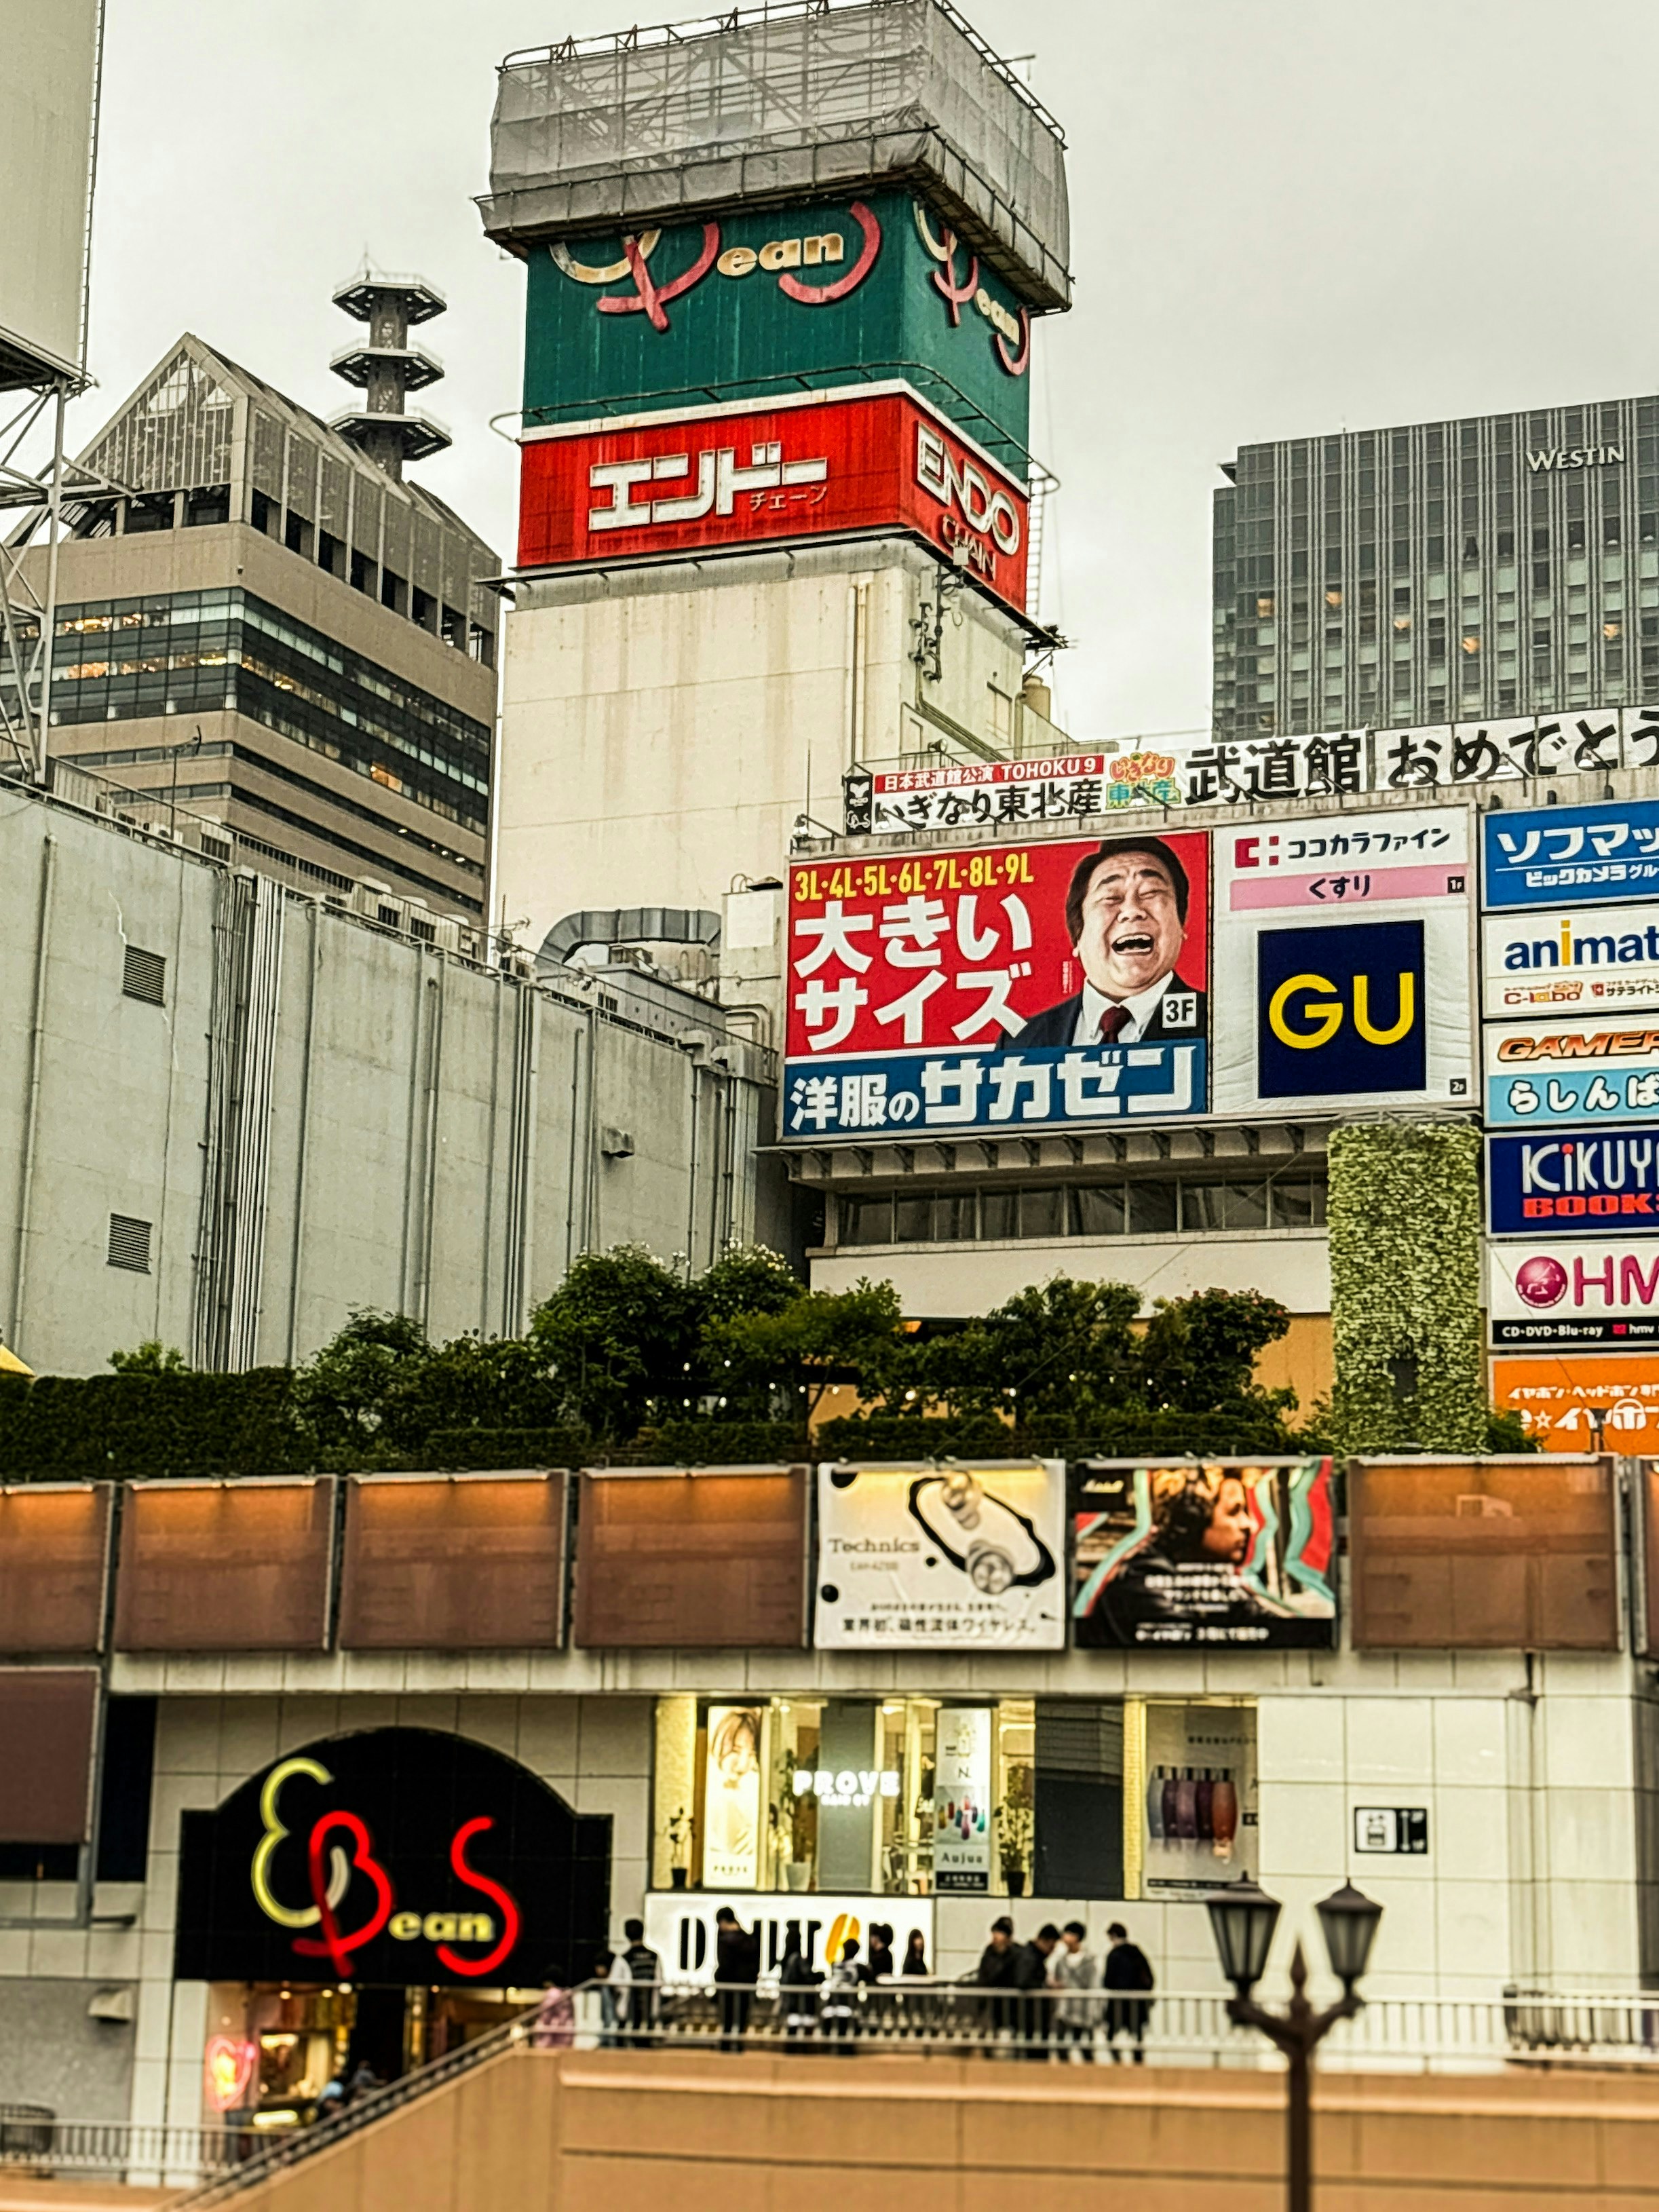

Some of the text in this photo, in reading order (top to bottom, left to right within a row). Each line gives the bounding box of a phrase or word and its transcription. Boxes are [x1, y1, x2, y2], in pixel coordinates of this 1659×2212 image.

[1527, 446, 1624, 472] WESTIN
[588, 441, 826, 531] エンドー
[750, 485, 827, 511] チェーン
[917, 421, 1019, 555] ENDO
[883, 766, 994, 791] 日本武道館公演
[875, 779, 1101, 830] いぎなり東北産
[1288, 828, 1450, 859] ココカラファイン
[1309, 875, 1371, 900] くすり
[1450, 879, 1462, 892] 1F
[794, 894, 1032, 978] 大きい
[795, 962, 1032, 1052] サイズ
[1166, 1000, 1194, 1023] 3F
[1269, 972, 1413, 1049] GU
[789, 1045, 1197, 1130] 洋服のサカゼン
[1451, 1081, 1464, 1093] 2F
[828, 1538, 919, 1553] Technics
[793, 1770, 900, 1797] PROVE
